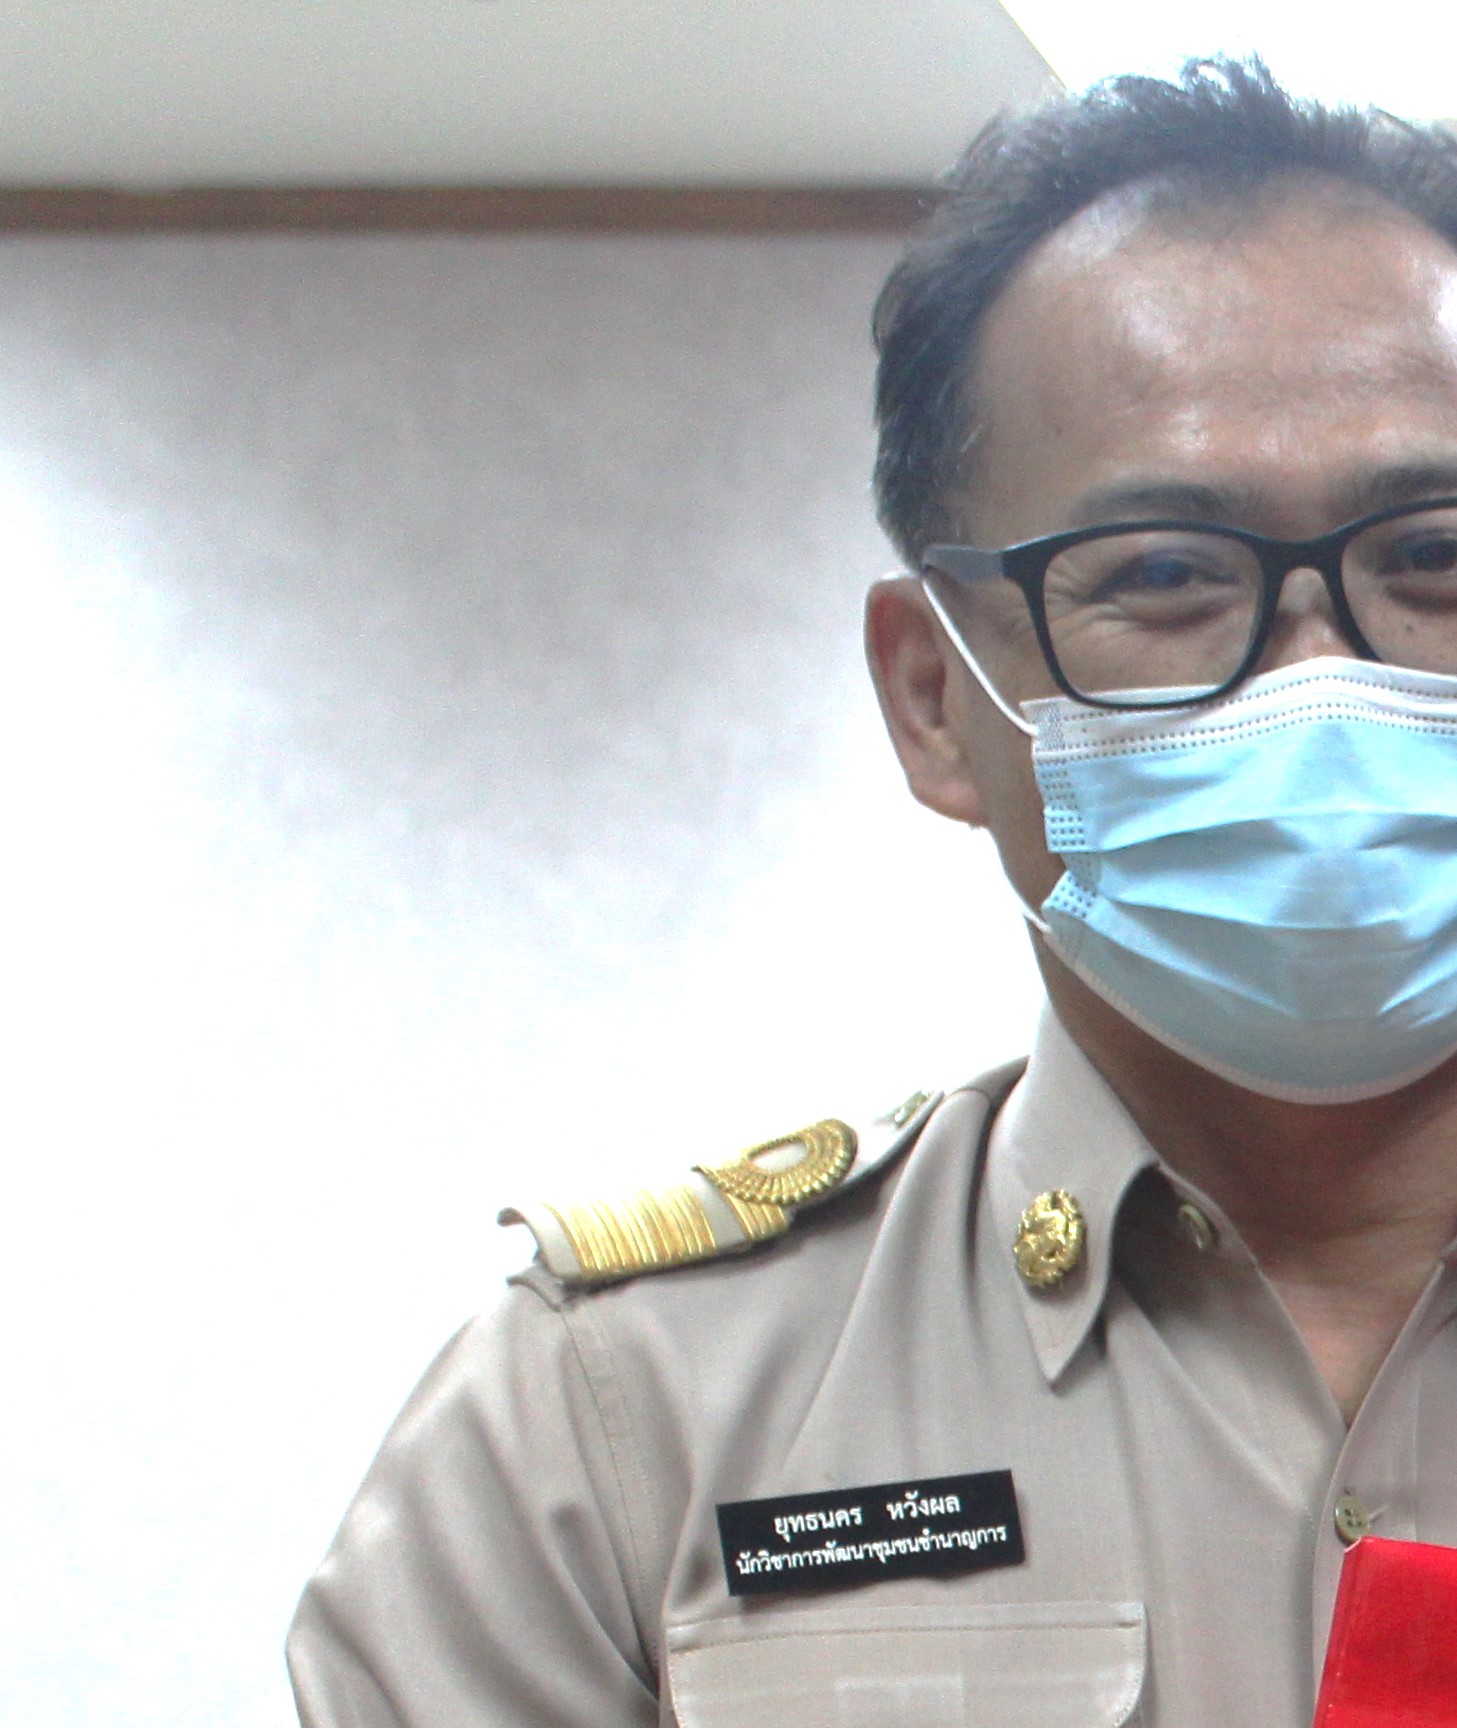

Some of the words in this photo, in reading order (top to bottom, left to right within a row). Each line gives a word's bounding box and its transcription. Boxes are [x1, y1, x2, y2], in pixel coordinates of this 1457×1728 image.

[774, 1506, 863, 1543] ยุทธนคร
[886, 1490, 961, 1521] หวังผล
[736, 1525, 1008, 1575] นักวิชาการพัฒนาชุมชนชำนาญการ
